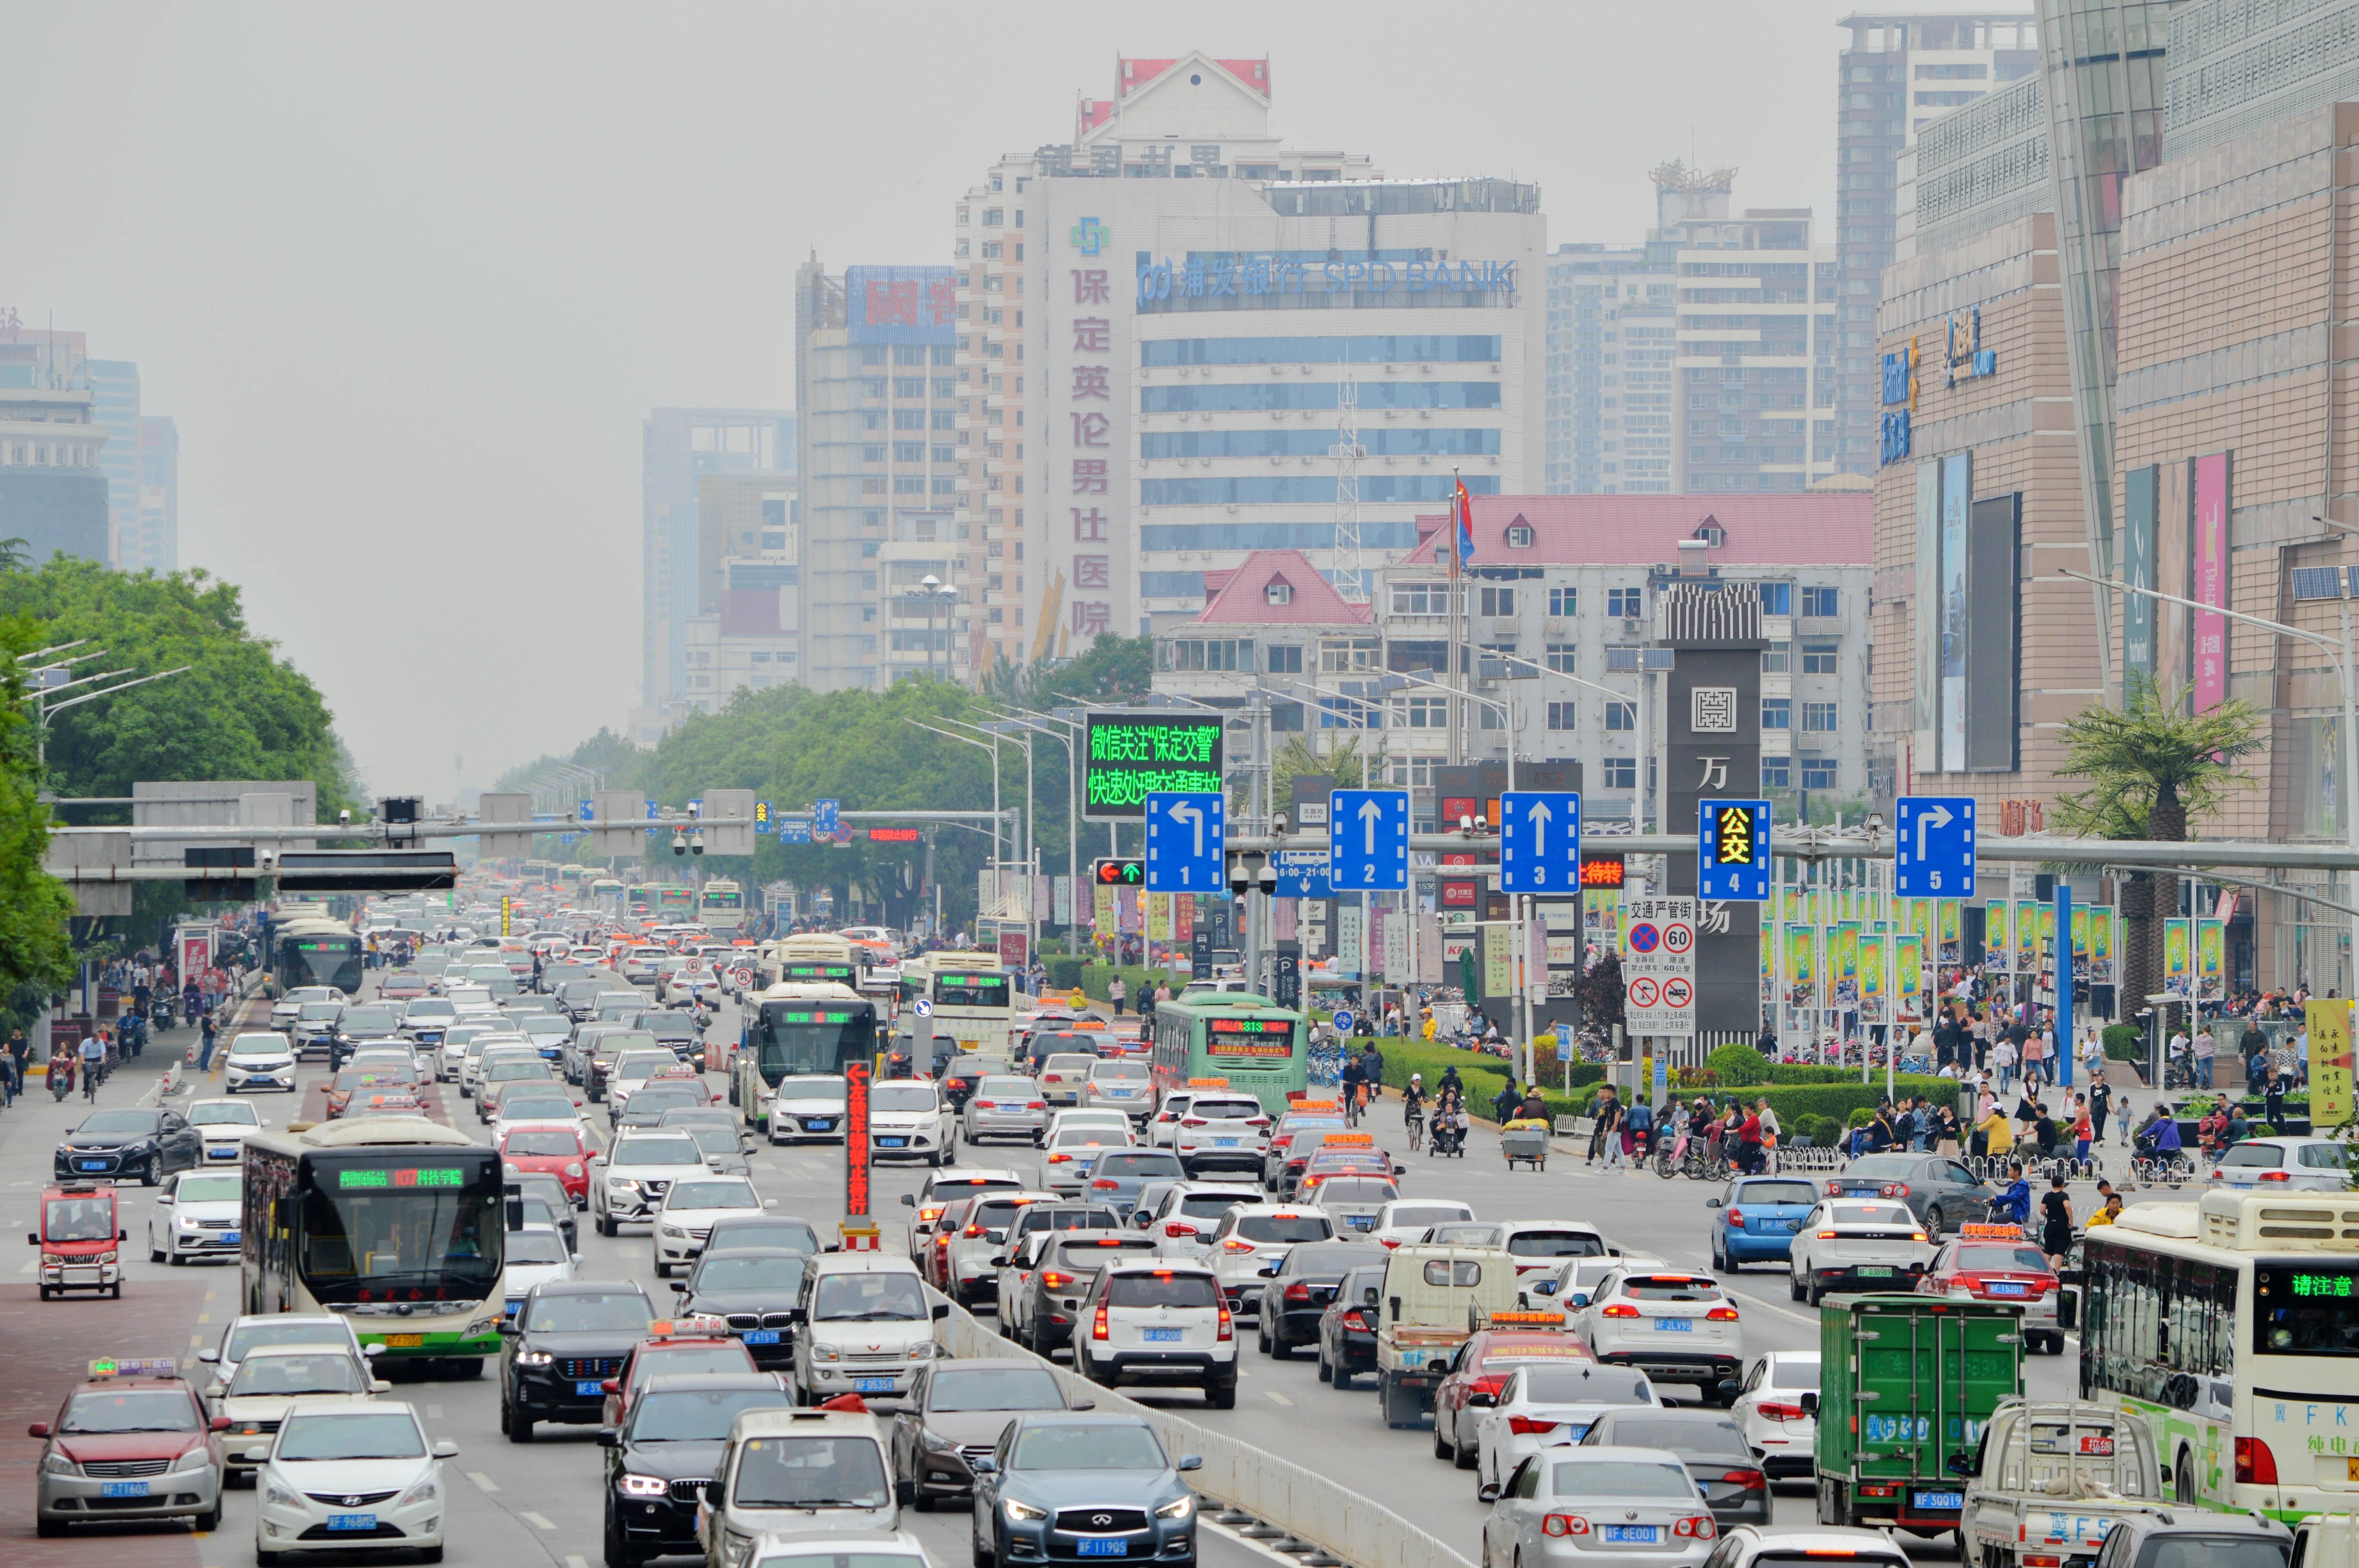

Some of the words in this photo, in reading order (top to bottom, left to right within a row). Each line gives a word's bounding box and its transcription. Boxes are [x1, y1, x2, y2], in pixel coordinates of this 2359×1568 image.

[1180, 256, 1308, 297] 浦发银行
[1323, 261, 1396, 293] SPD
[1405, 260, 1516, 293] BANK
[1881, 348, 1908, 406] Walmart
[1069, 269, 1110, 635] 保定英伦男仕医院
[2129, 637, 2147, 663] hotwind
[1088, 768, 1221, 805] 快速处理交通事故
[756, 802, 767, 822] 公交
[1721, 808, 1750, 864] 公交
[1180, 866, 1189, 885] 1
[1364, 864, 1375, 883] 2
[1534, 867, 1545, 885] 3
[1728, 873, 1740, 892] 4
[1930, 871, 1942, 890] 5
[1631, 901, 1692, 919] 交通严管街
[1943, 908, 1955, 932] 六大中心
[1990, 912, 2003, 940] 六大中心
[2021, 913, 2033, 940] 六大中心
[2073, 916, 2085, 945] 六大中心
[2094, 920, 2106, 949] 六大中心
[1669, 931, 1687, 945] 60
[2170, 934, 2183, 963] 六大中心
[2204, 934, 2217, 963] 六大中心
[1796, 942, 1811, 973] 六大中心
[1842, 936, 1856, 967] 六大中心
[1281, 961, 1291, 973] P
[1631, 964, 1659, 973] 禁止停车
[1664, 964, 1691, 973] 60公里
[1864, 952, 1877, 984] 六大中心
[1901, 952, 1915, 984] 六大中心
[942, 976, 965, 985] 请注意
[1243, 1021, 1263, 1031] 313
[1664, 1011, 1693, 1020] 禁止0.6吨以
[1665, 1021, 1689, 1029] 上货车通行
[395, 1170, 418, 1186] 107
[418, 1169, 463, 1185] 科技学院
[2292, 1274, 2353, 1297] 请注意
[2088, 1439, 2113, 1453] 拉货
